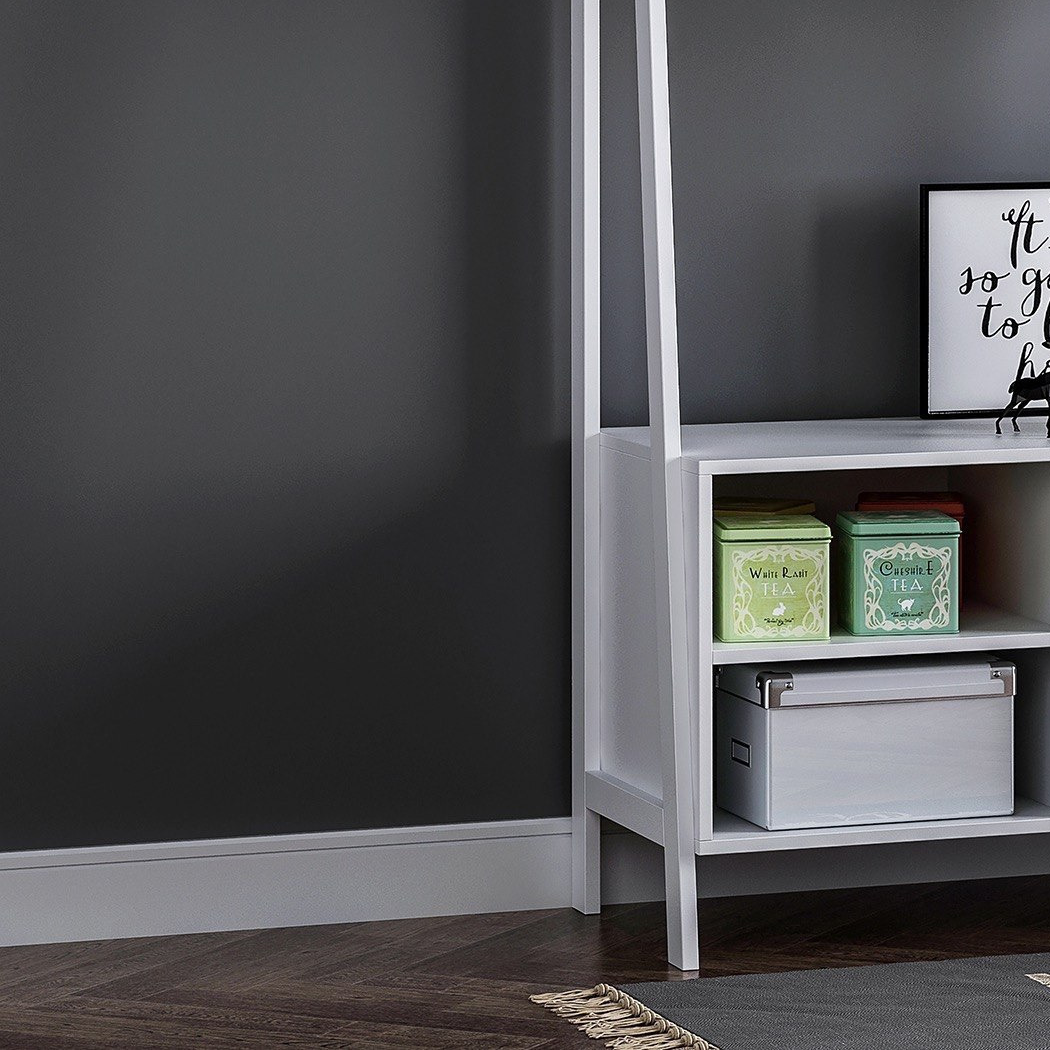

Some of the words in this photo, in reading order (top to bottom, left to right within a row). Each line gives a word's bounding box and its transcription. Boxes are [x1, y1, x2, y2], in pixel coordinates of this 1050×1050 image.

[959, 266, 1011, 295] so
[976, 296, 1031, 339] to
[761, 582, 796, 596] TEA
[890, 578, 924, 592] TEA
